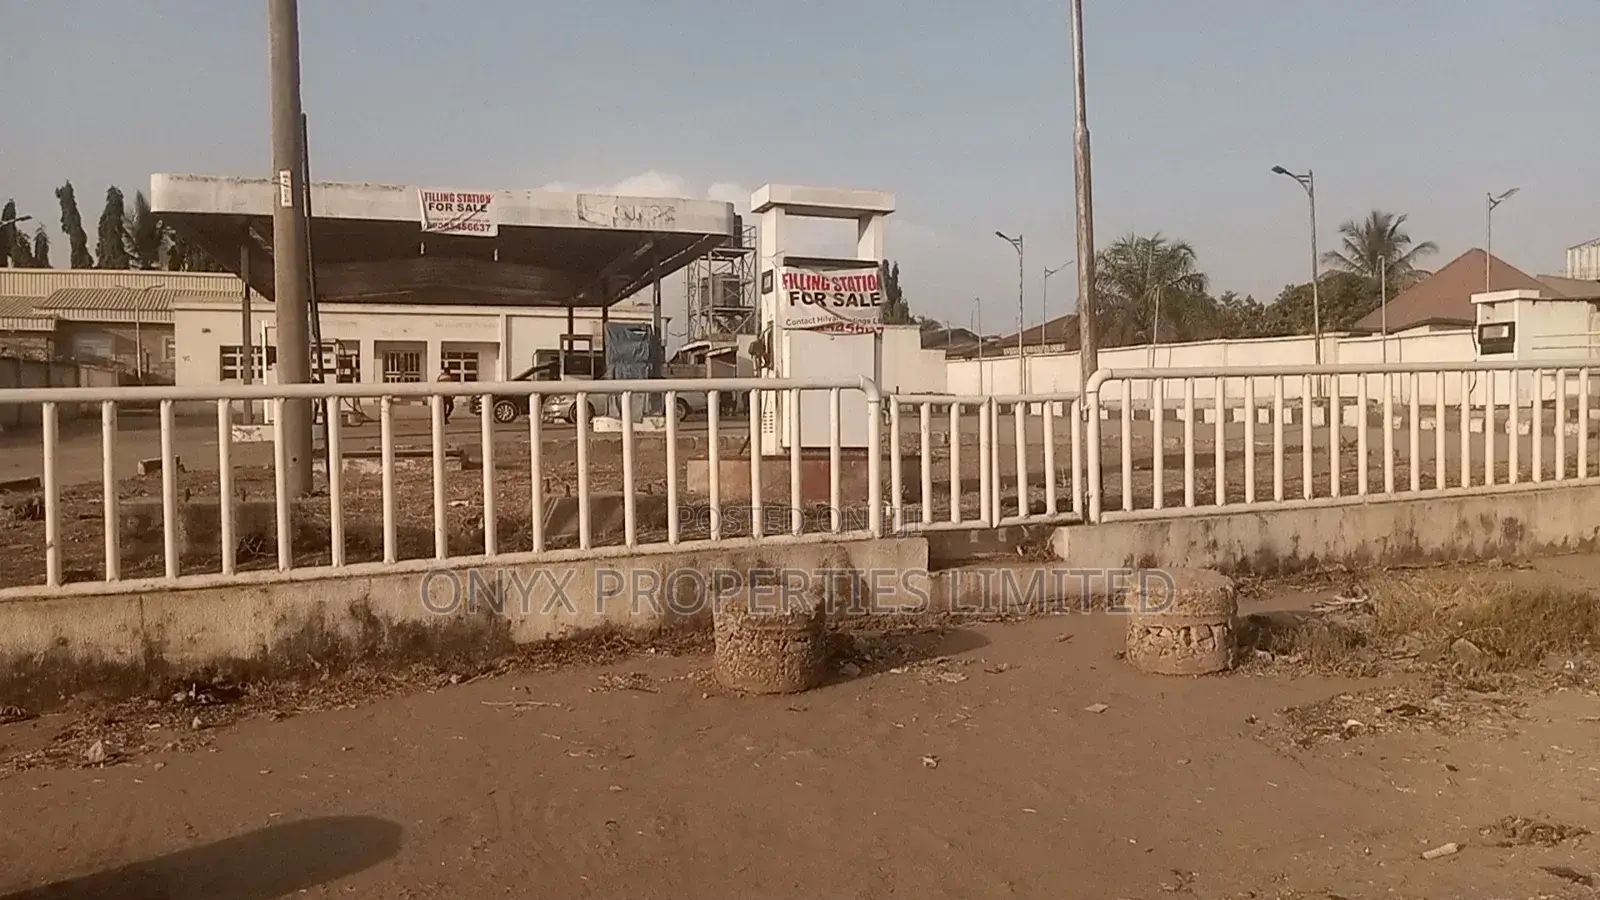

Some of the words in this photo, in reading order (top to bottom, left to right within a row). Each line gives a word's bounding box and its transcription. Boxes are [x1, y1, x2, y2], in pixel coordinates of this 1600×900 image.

[424, 192, 455, 203] FILLING
[456, 193, 491, 204] STATION
[428, 203, 453, 212] FOR
[457, 203, 488, 213] SALE
[781, 273, 830, 291] FILLING
[789, 291, 827, 308] FOR
[833, 292, 882, 308] SALE
[785, 317, 816, 327] Contact
